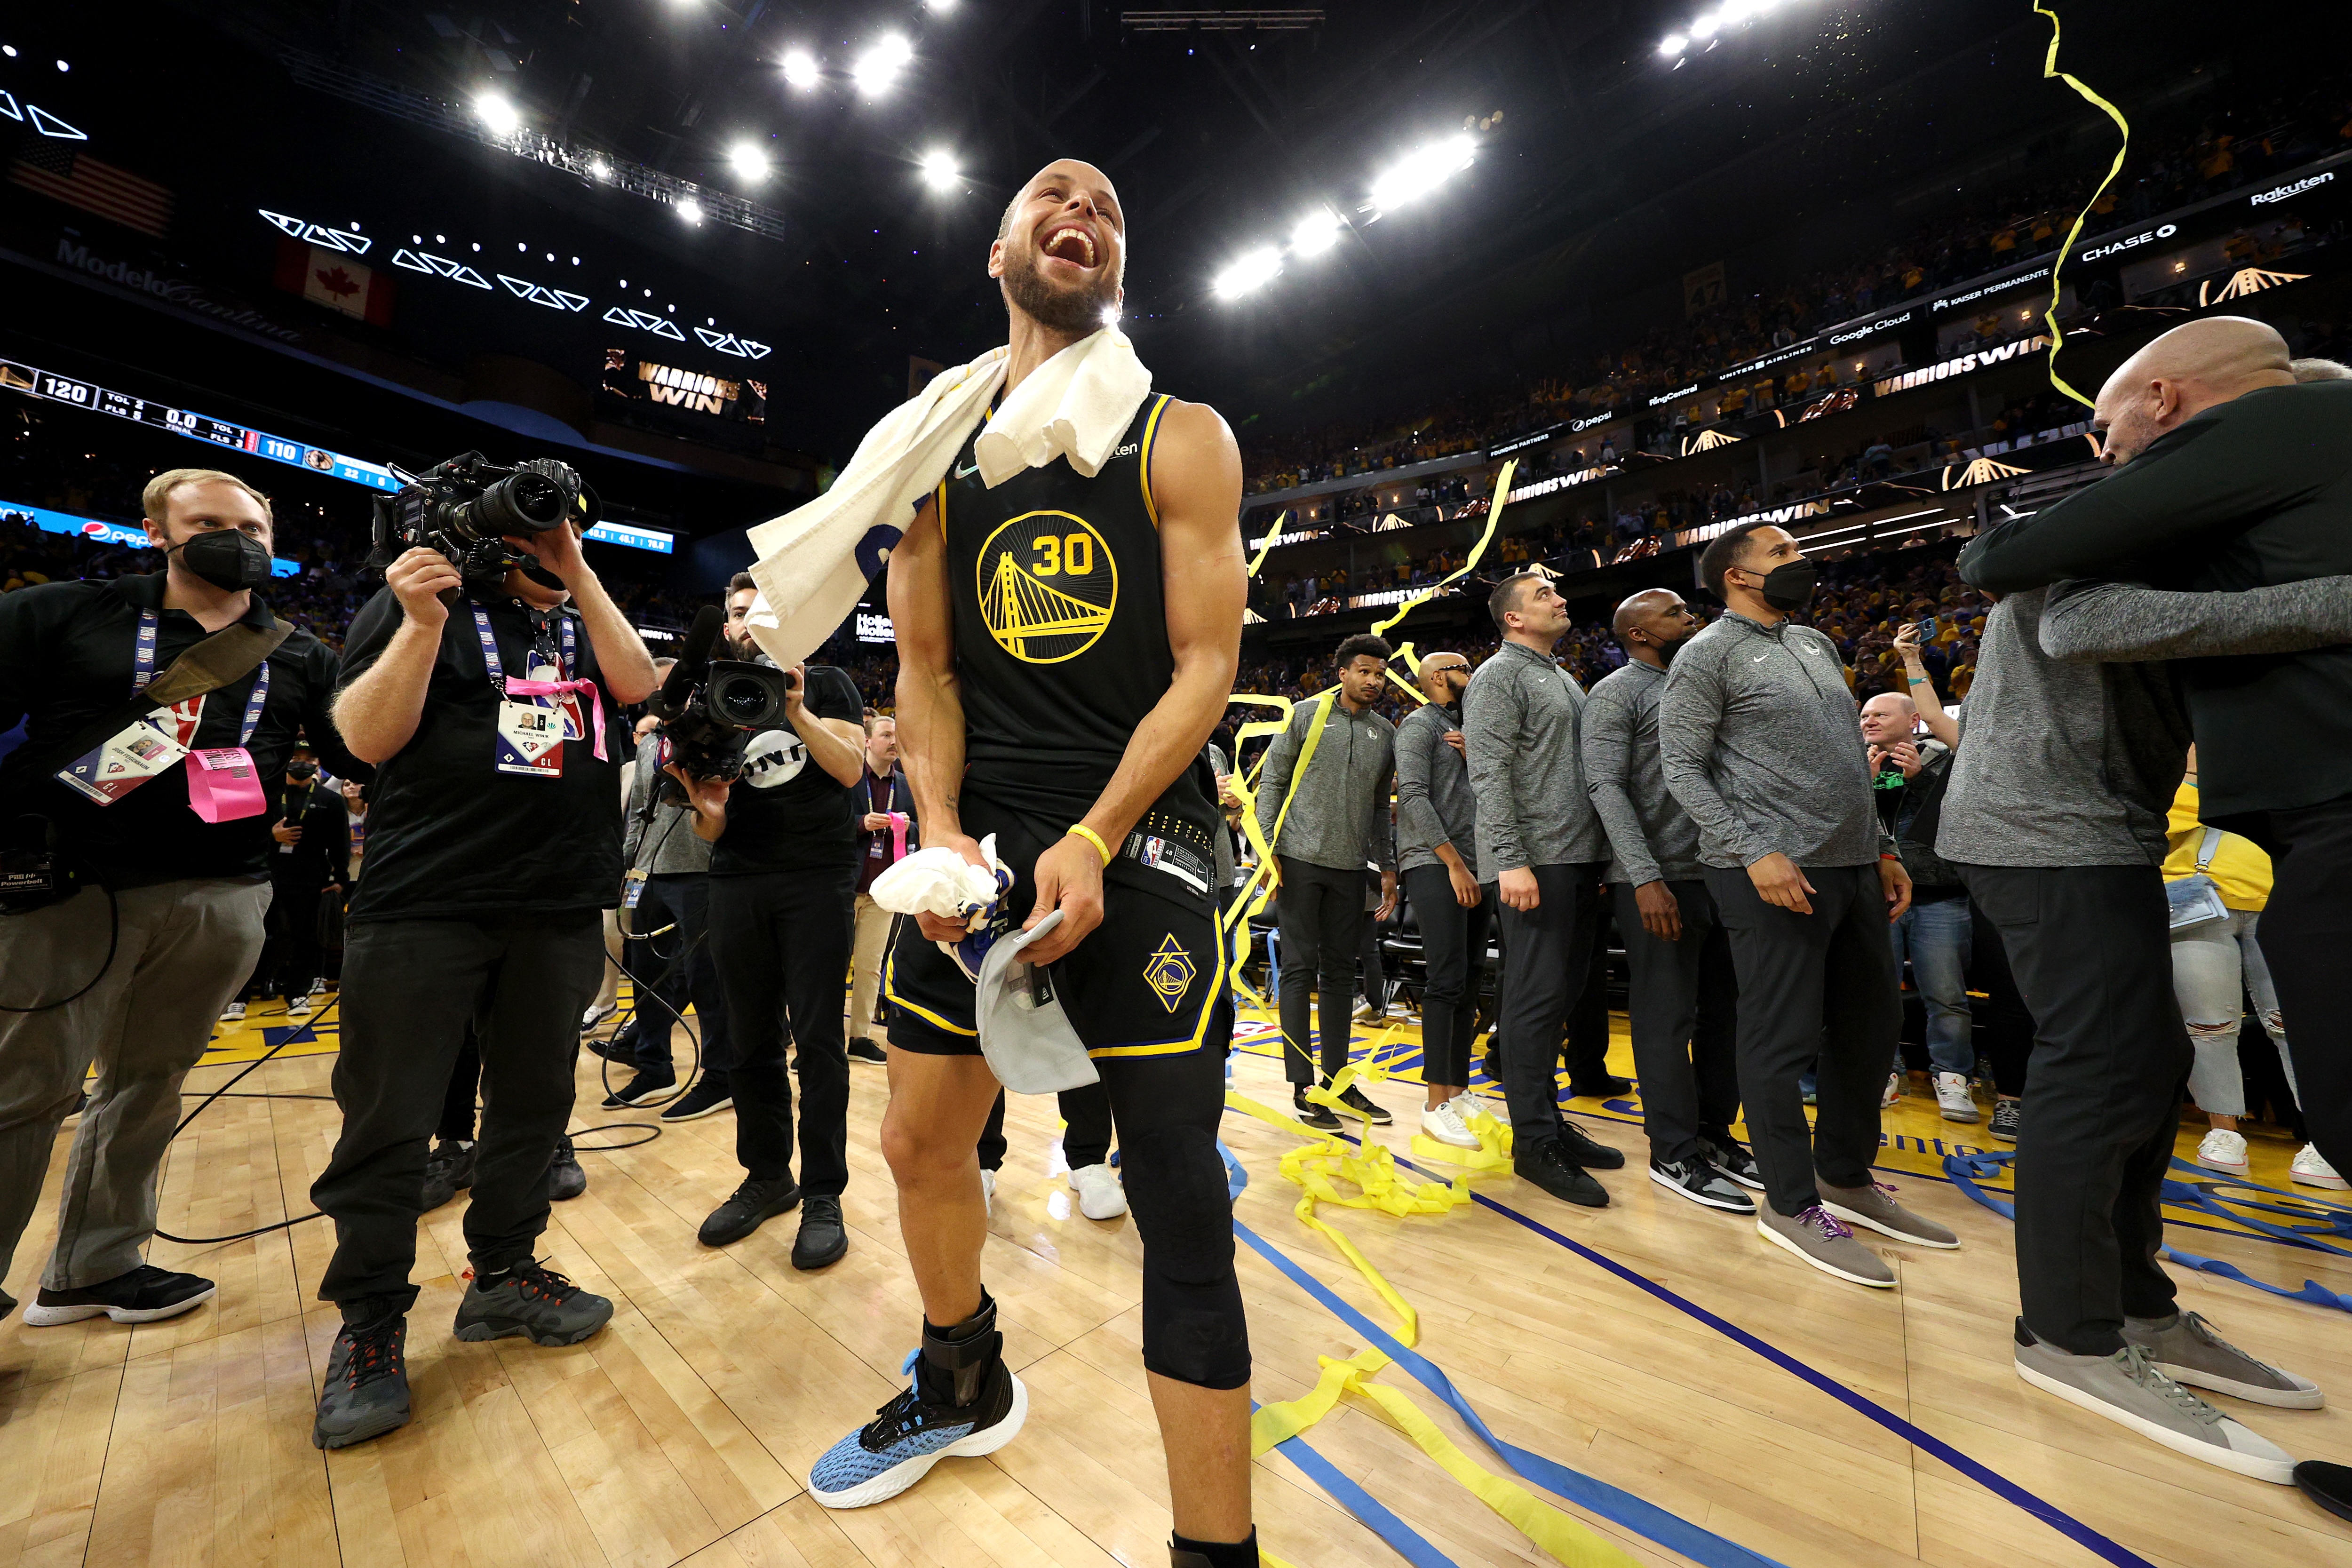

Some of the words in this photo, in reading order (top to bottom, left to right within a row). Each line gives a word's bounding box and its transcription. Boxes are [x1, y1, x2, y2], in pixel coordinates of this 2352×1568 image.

[2251, 172, 2335, 206] Rakuten
[2082, 231, 2154, 262] CHASE
[56, 239, 170, 295] Modelo
[1951, 290, 1982, 306] KAISER
[1984, 268, 2050, 295] PERMANENTE
[1829, 325, 1874, 345] Google
[1874, 312, 1911, 331] Cloud
[1719, 365, 1755, 380] UNITED
[1765, 345, 1812, 366] AIRLINES
[638, 360, 741, 401] WARRIORS
[1873, 353, 1977, 398] WARRIORS
[45, 378, 87, 403] 120
[649, 383, 724, 415] WIN
[1649, 383, 1698, 406] RingCentral
[106, 393, 130, 405] TOL
[134, 399, 144, 410] 2
[104, 404, 127, 415] FLS
[133, 410, 142, 421] 5
[166, 409, 197, 429] 0.0
[1585, 411, 1612, 428] pepsi
[166, 423, 193, 435] FINAL
[212, 422, 233, 434] TOL
[239, 430, 246, 438] 1
[210, 433, 230, 444] FLS
[235, 439, 244, 448] 3
[266, 440, 296, 460] 110
[1490, 443, 1518, 457] FOUNDING
[1518, 433, 1549, 448] PARTNERS
[343, 467, 359, 479] 22
[1559, 464, 1607, 488] WIN
[1760, 499, 1830, 524] WIN
[1282, 529, 1319, 544] WIN
[1032, 533, 1093, 577] 30
[1348, 589, 1406, 608] WARRIORS
[474, 612, 488, 622] NBA
[140, 626, 156, 637] NBA
[479, 632, 494, 642] NBA
[138, 647, 154, 659] NBA
[485, 652, 499, 662] NBA
[135, 671, 152, 684] NBA
[260, 672, 269, 683] NBA
[251, 692, 266, 703] NBA
[246, 713, 260, 723] NBA
[112, 747, 125, 756] JOSH
[123, 751, 150, 771] FEIGENBAUM
[743, 742, 804, 777] TNT
[1150, 952, 1190, 995] 75
